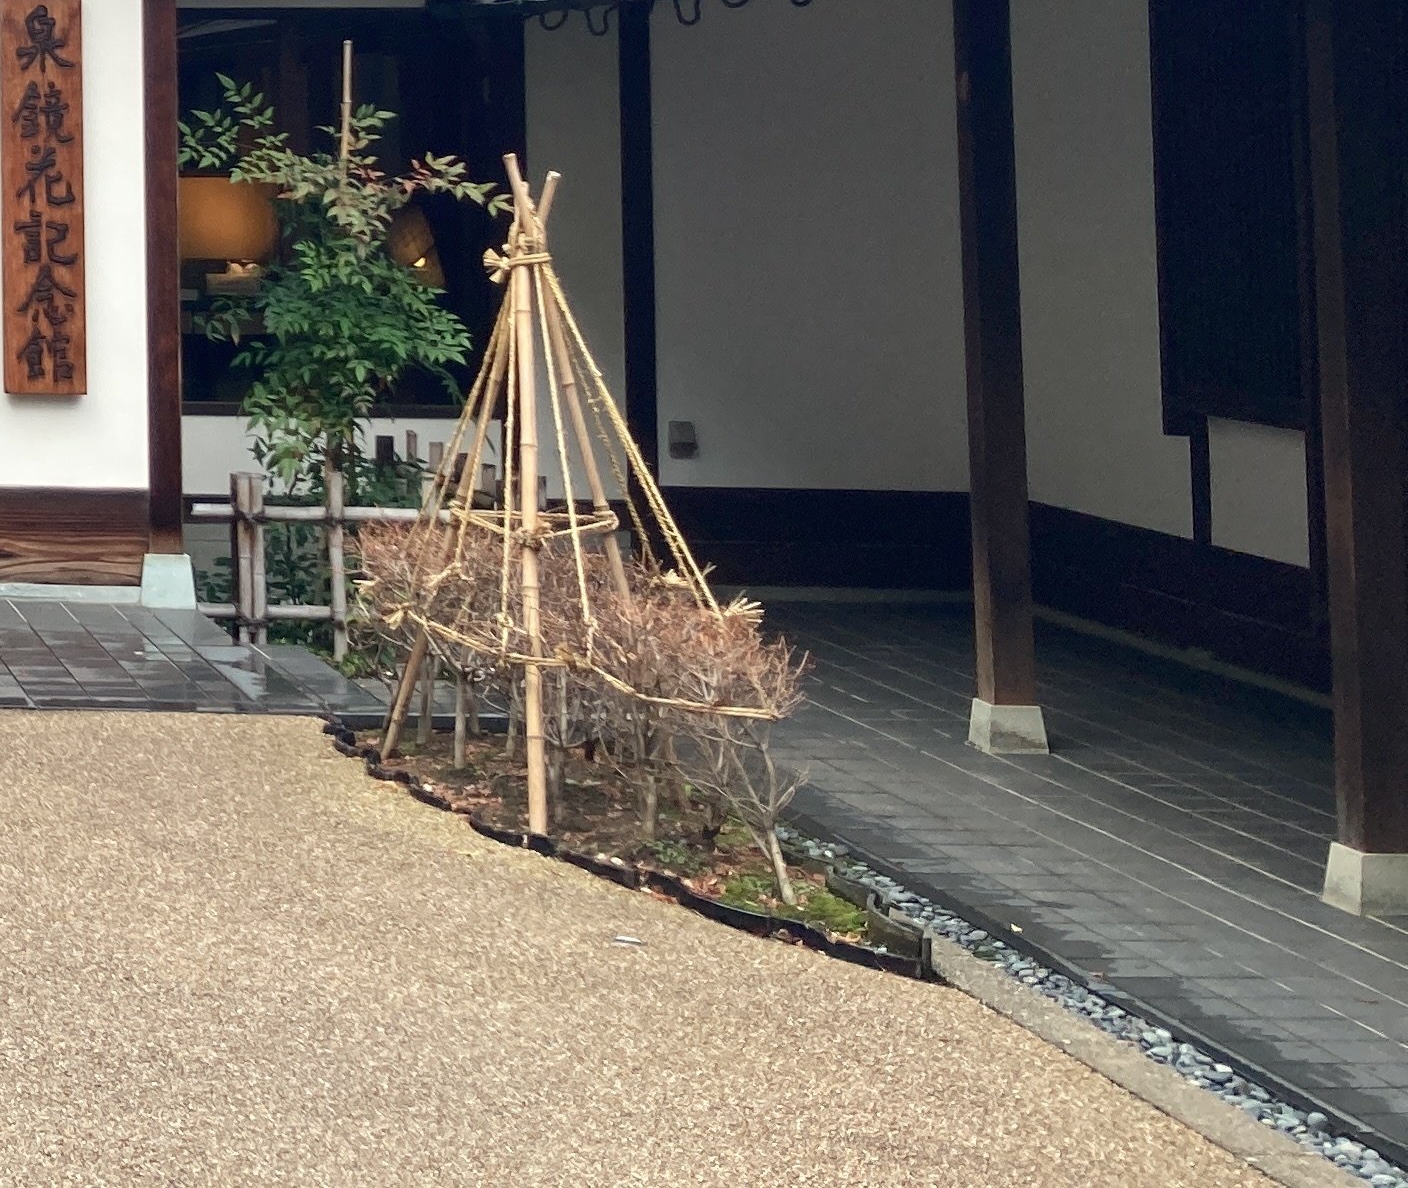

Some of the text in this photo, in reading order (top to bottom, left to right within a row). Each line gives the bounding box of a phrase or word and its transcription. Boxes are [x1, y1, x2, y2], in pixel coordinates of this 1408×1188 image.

[12, 4, 79, 383] 泉鏡花記念館
